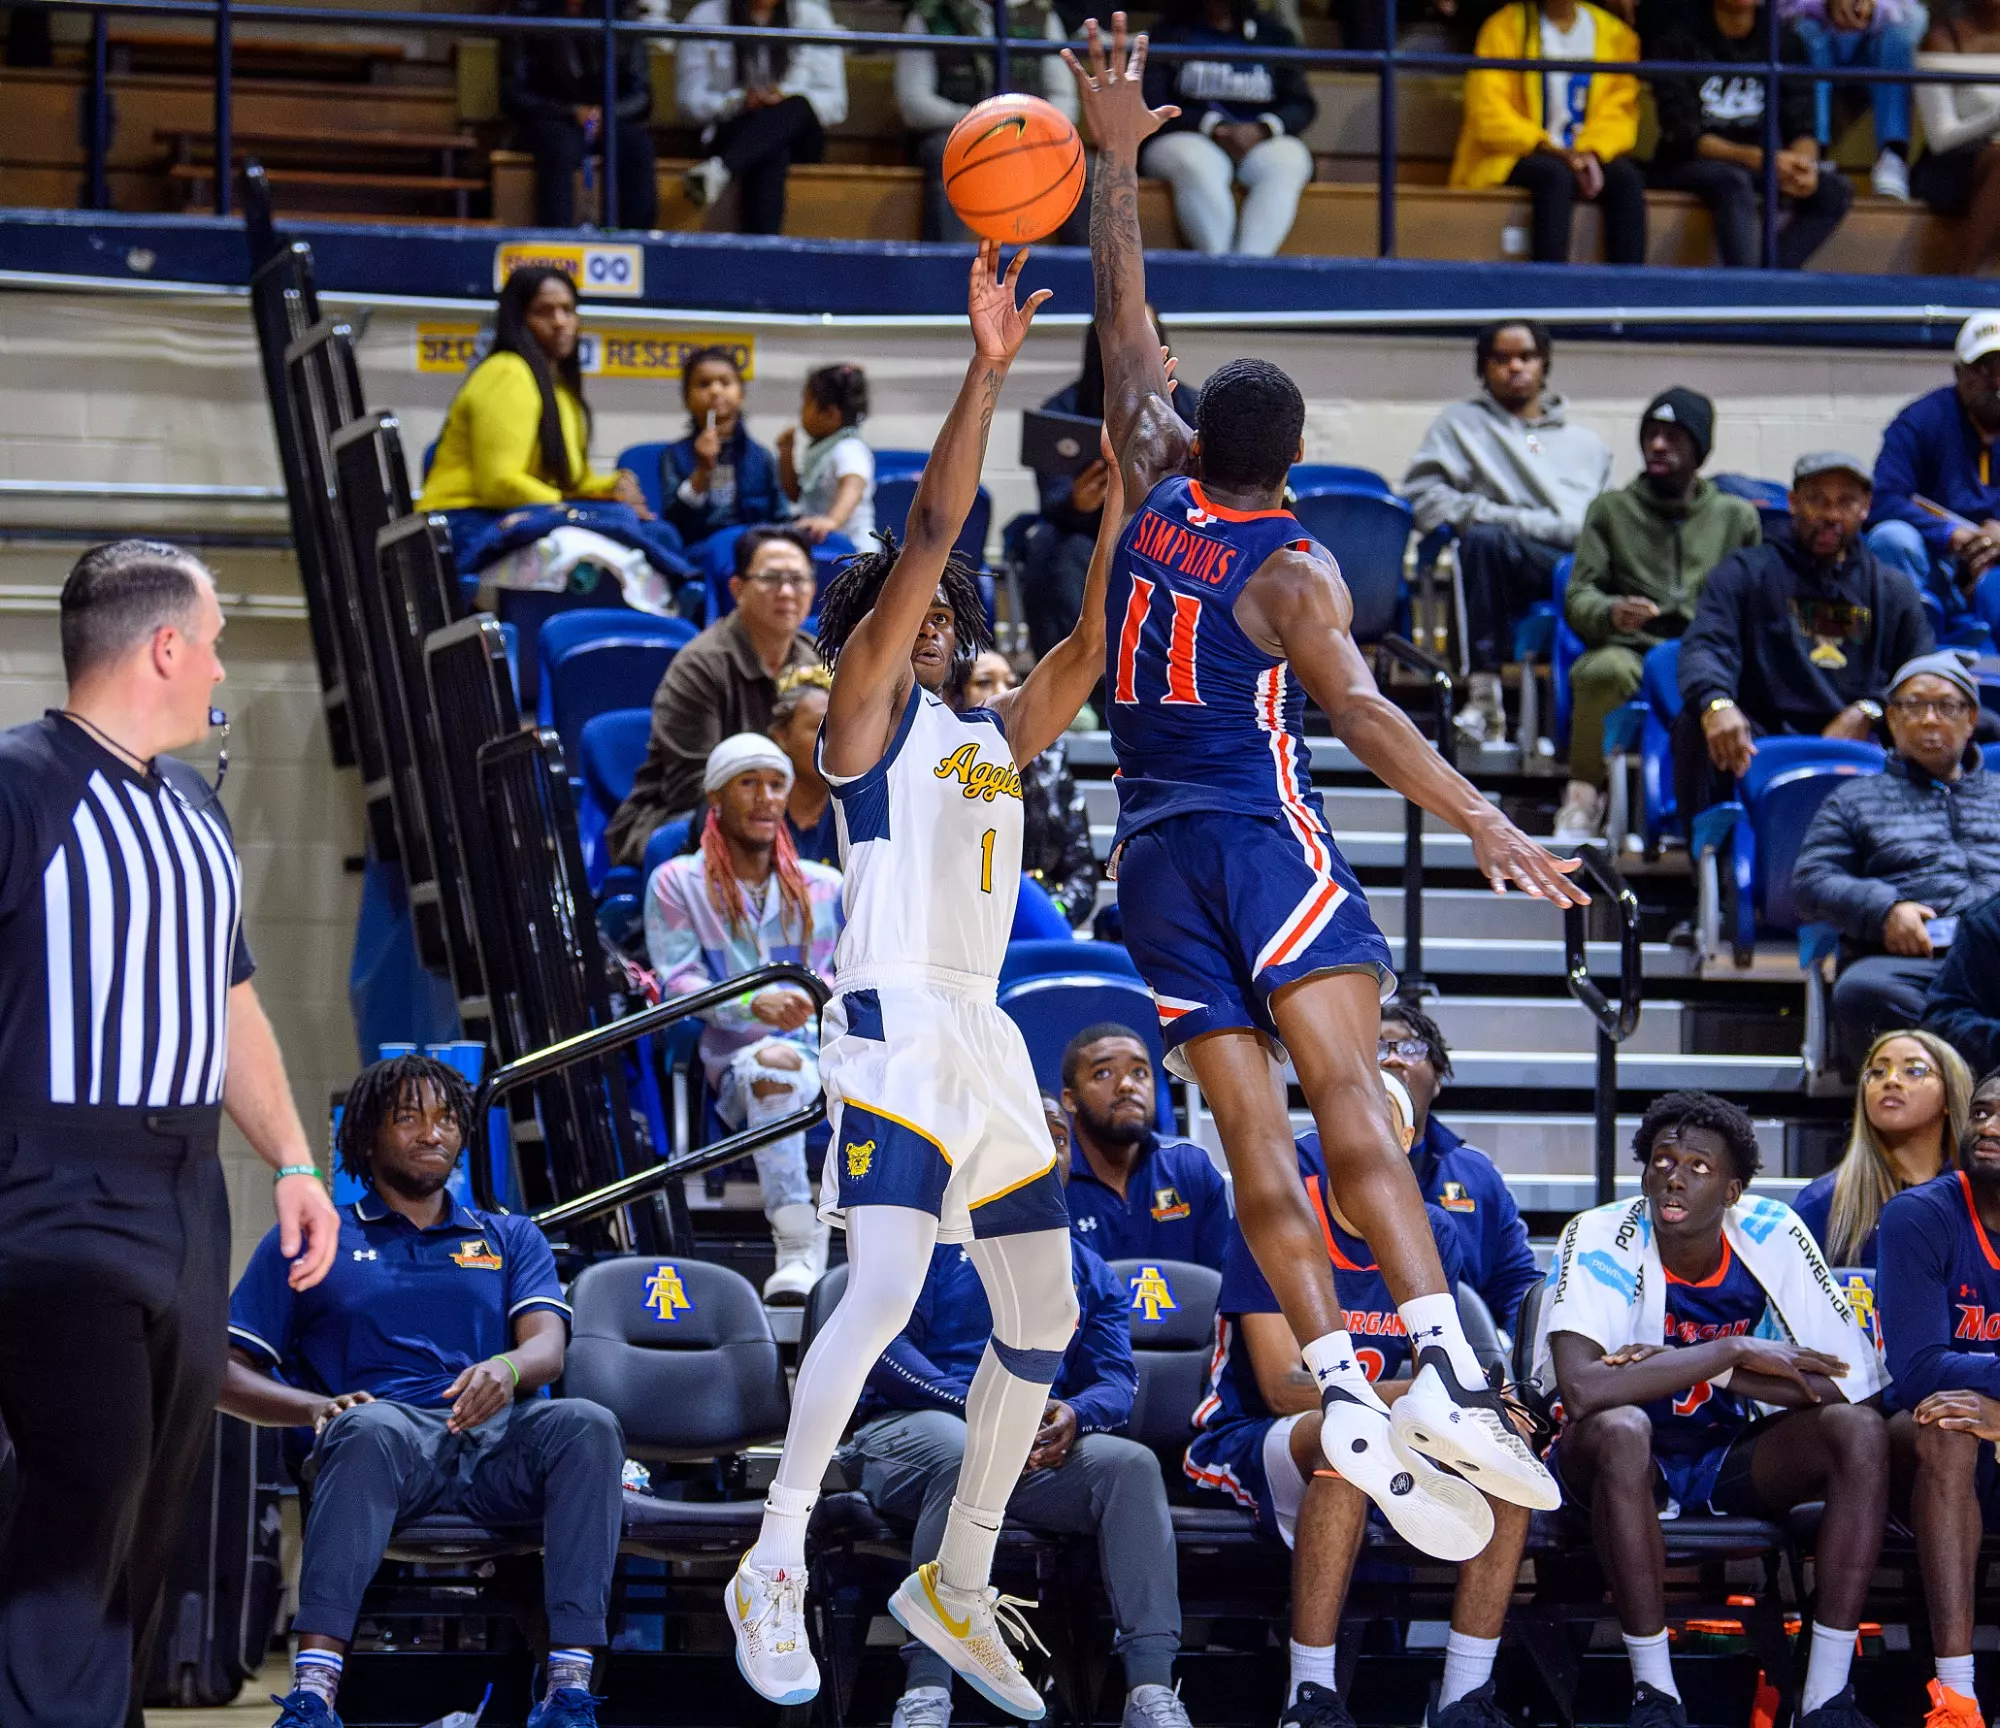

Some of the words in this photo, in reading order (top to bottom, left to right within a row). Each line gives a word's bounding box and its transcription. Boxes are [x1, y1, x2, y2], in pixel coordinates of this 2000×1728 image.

[1133, 511, 1237, 584] SIMPKINS
[1115, 572, 1207, 706] 11
[981, 828, 997, 893] 1
